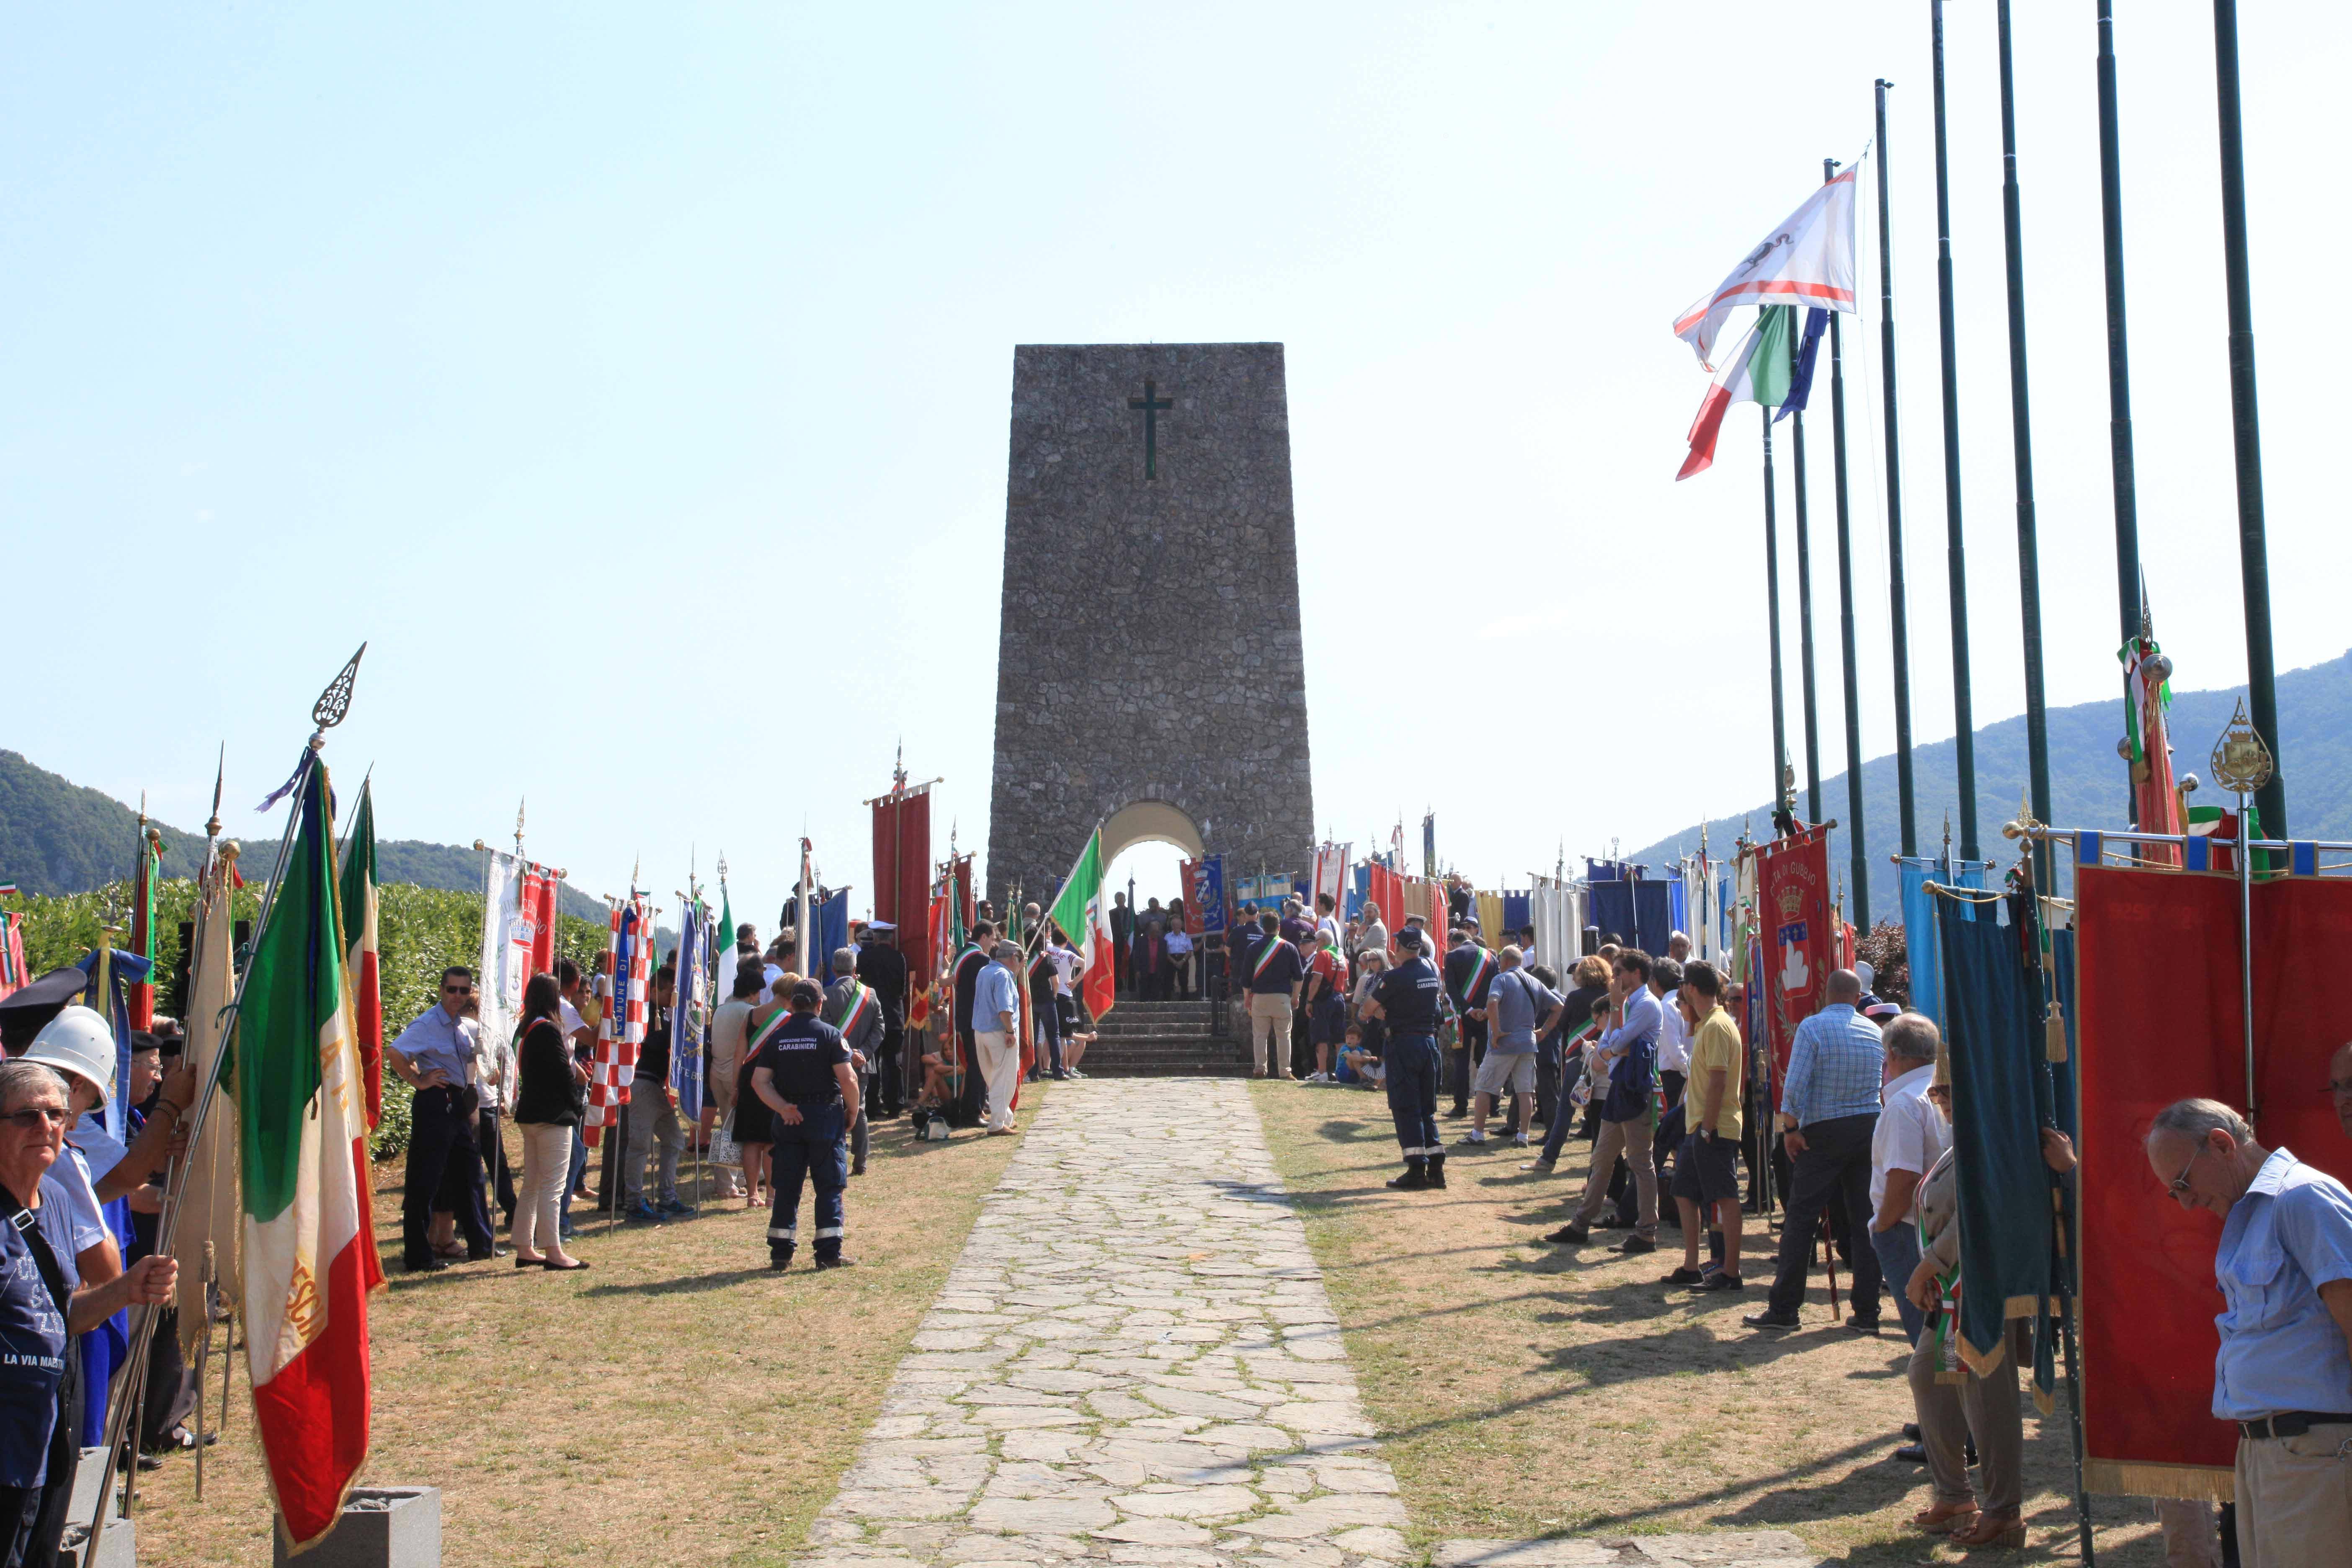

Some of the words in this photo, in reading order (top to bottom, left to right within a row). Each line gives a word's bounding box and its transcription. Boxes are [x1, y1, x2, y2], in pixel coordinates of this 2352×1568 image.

[619, 959, 627, 972] DI
[616, 980, 626, 1031] COMUNE
[4, 1354, 18, 1364] LA
[21, 1355, 38, 1366] VIA
